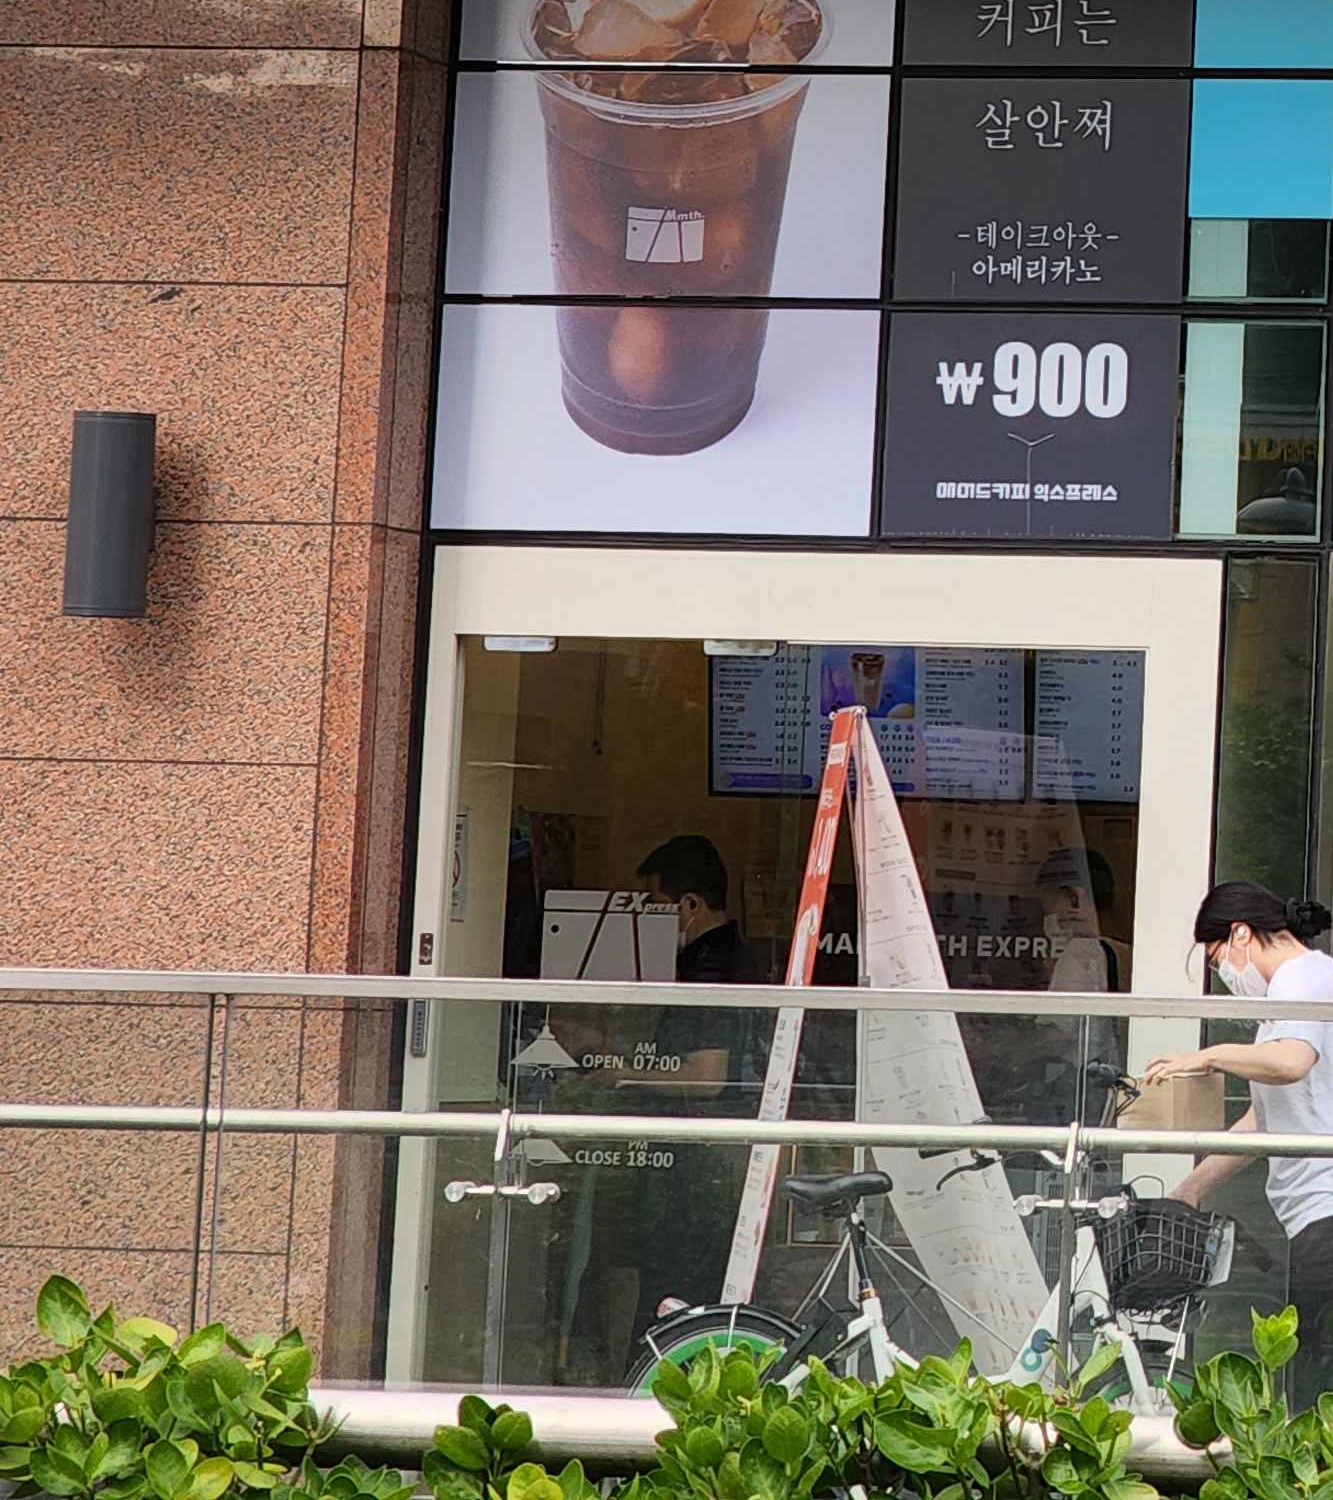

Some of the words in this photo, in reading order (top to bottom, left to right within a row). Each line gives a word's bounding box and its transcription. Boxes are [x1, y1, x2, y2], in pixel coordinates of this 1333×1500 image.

[975, 99, 1113, 152] 살안쪄
[972, 255, 1102, 285] 아메리카노
[634, 1041, 657, 1055] AM
[582, 1054, 624, 1070] OPEN
[633, 1054, 681, 1072] 07:00
[574, 1150, 622, 1167] CLOSE
[626, 1150, 674, 1169] 18:00
